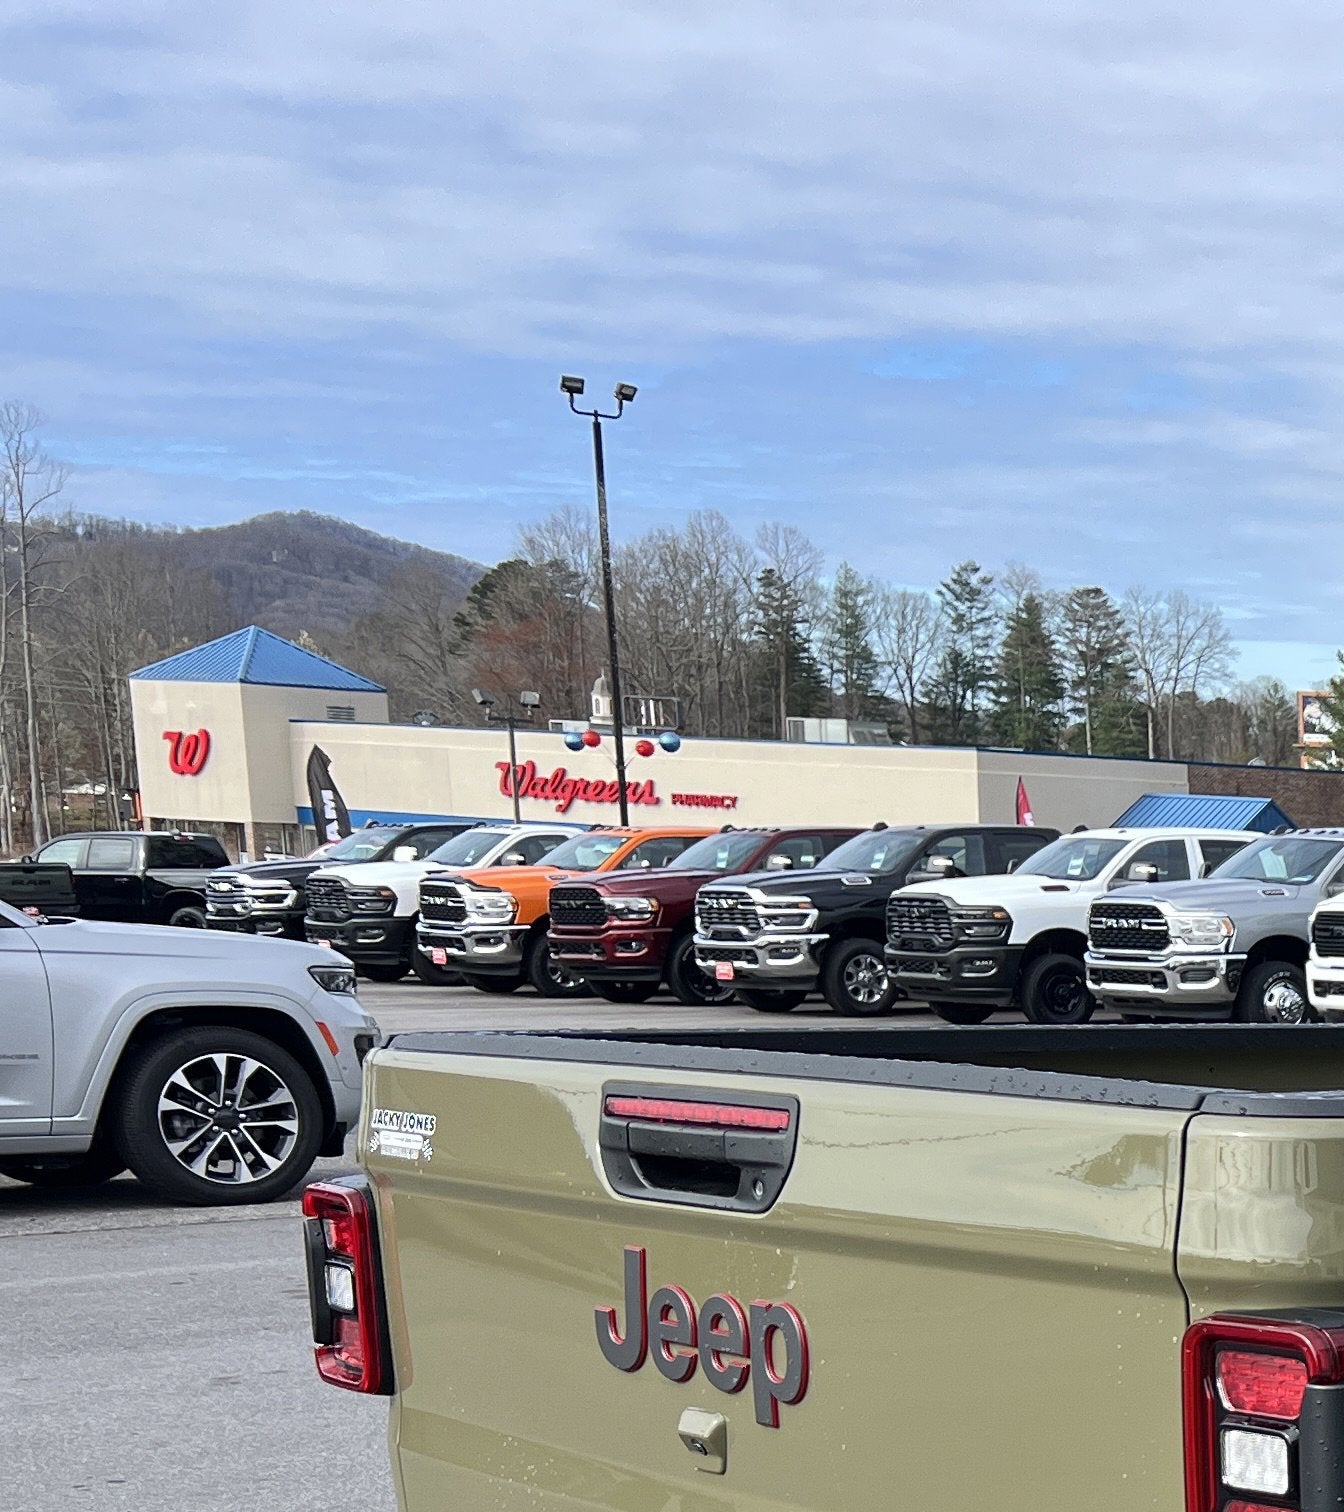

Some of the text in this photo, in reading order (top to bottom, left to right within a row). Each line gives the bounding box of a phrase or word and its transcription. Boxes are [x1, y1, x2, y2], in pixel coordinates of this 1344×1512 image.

[162, 728, 210, 776] W
[371, 1109, 436, 1135] JACKY JONES
[594, 1244, 810, 1429] Jeep
